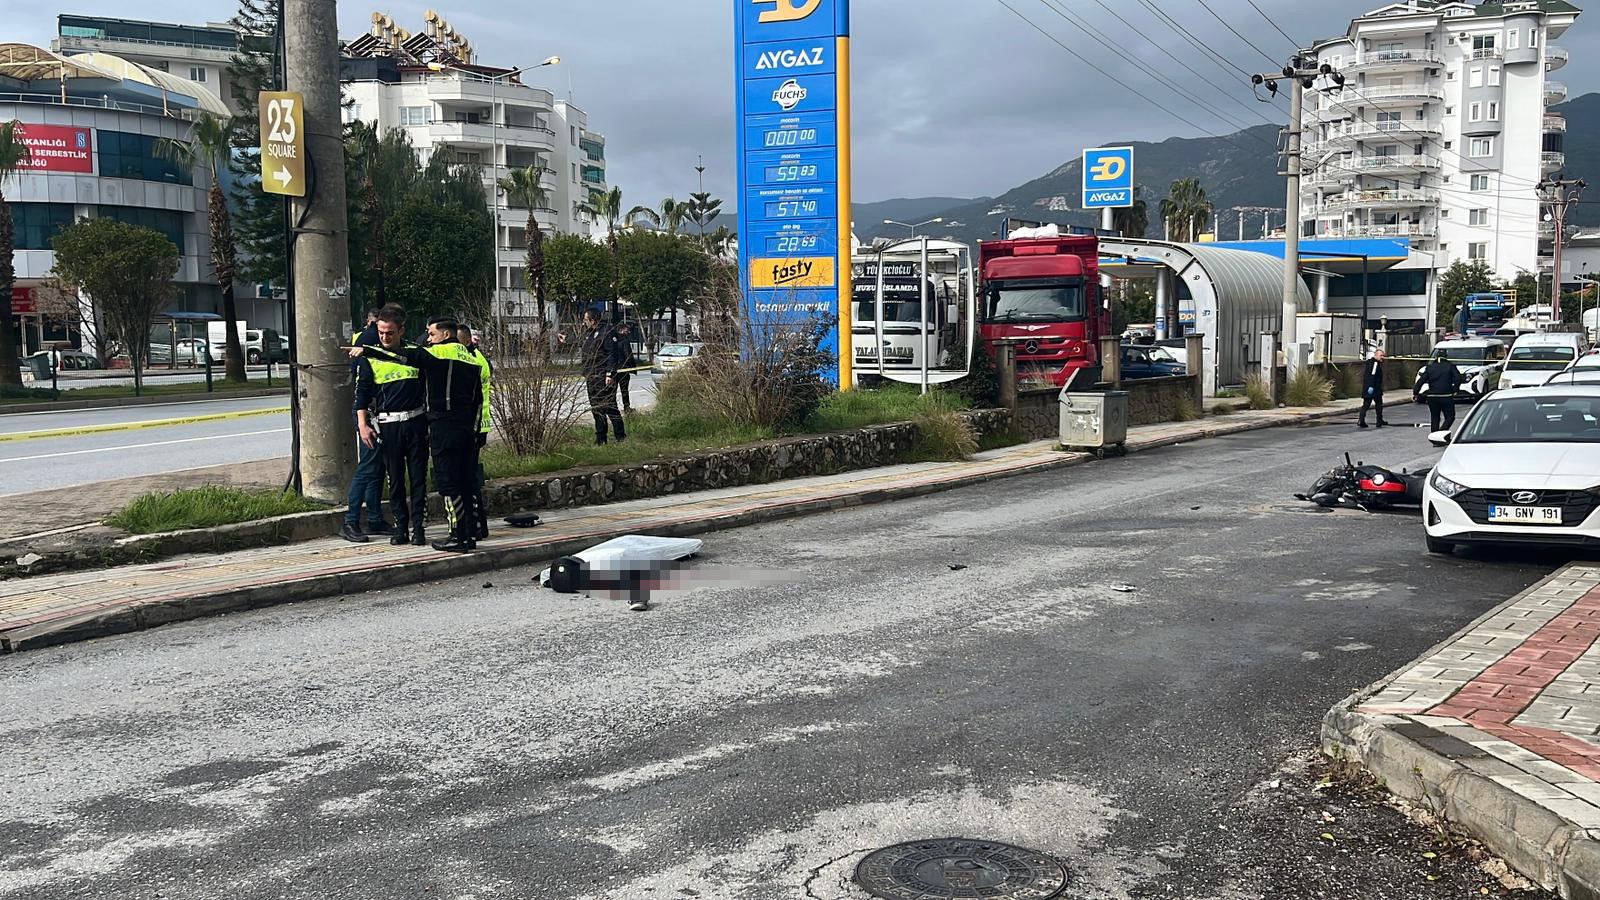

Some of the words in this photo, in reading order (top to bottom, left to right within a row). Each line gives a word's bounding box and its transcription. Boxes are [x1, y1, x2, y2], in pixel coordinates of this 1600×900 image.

[755, 47, 824, 70] AYGAZ
[774, 90, 806, 100] FUCHS
[267, 99, 296, 144] 23
[765, 131, 797, 146] 000
[800, 129, 815, 140] 00
[35, 149, 87, 159] SERBESTLİK
[268, 143, 297, 159] SQUARE
[801, 165, 816, 176] 83
[1089, 192, 1126, 202] AYGAZ
[802, 201, 816, 211] 40
[772, 260, 812, 284] fasty
[866, 264, 912, 275] TÜKCİOĞLU
[855, 284, 878, 292] HUZU
[882, 284, 918, 292] İSLAMDA
[1496, 507, 1508, 517] 34
[1515, 507, 1534, 518] GNV
[1542, 508, 1558, 519] 191
